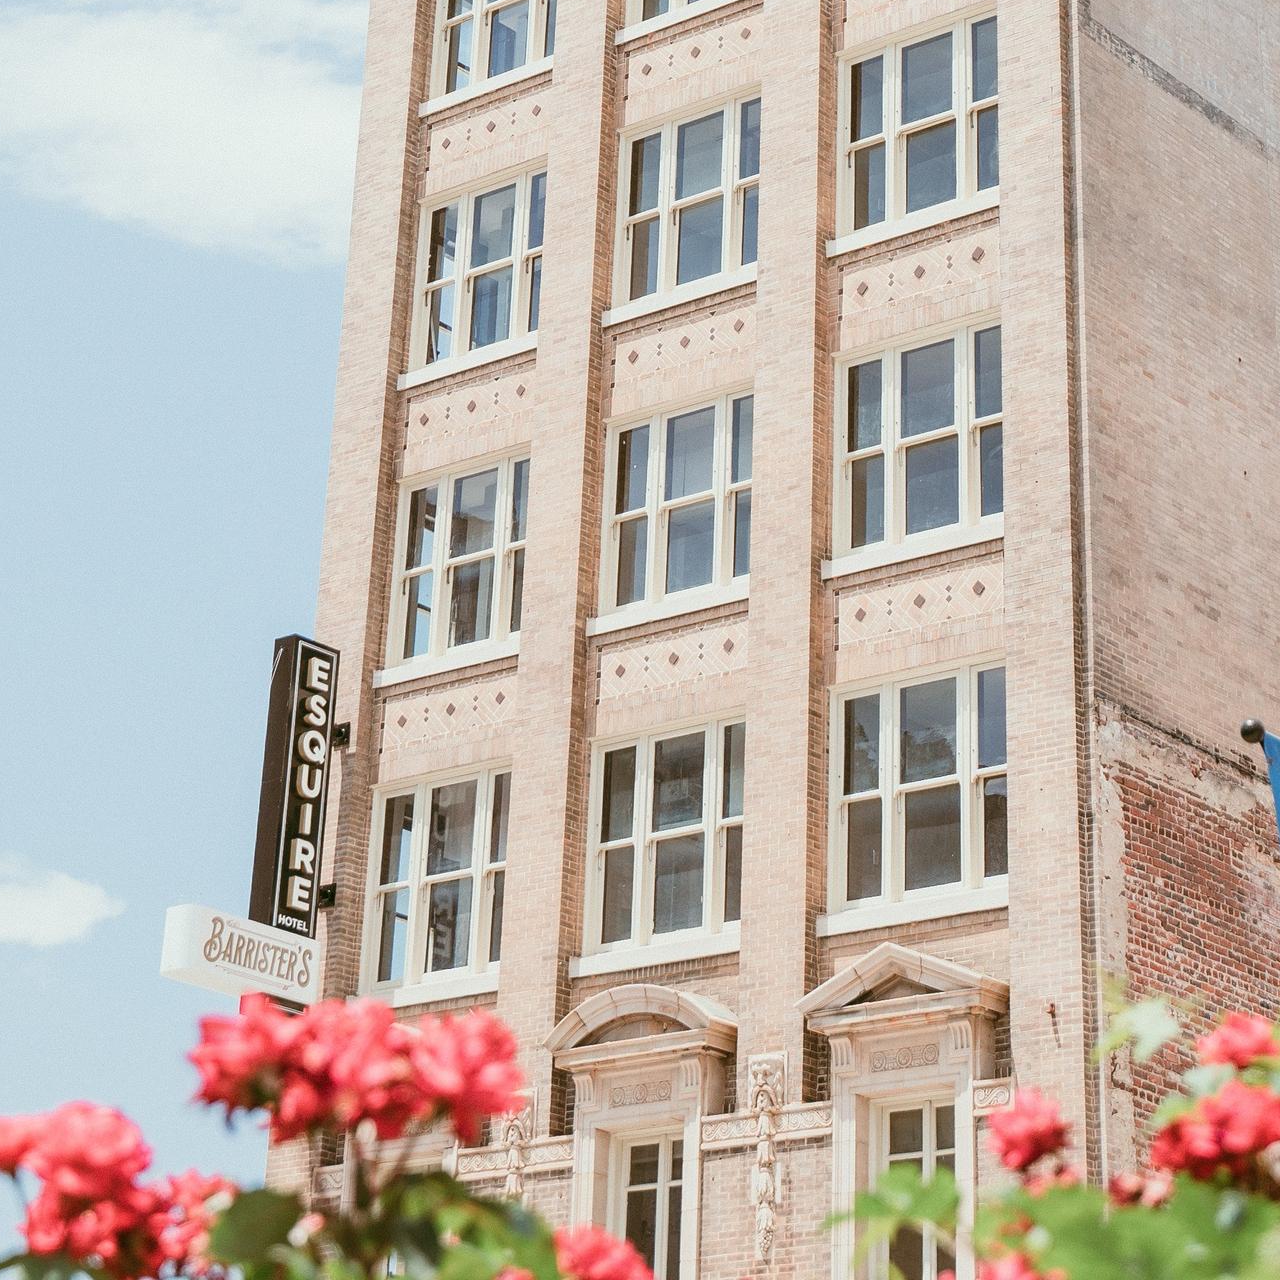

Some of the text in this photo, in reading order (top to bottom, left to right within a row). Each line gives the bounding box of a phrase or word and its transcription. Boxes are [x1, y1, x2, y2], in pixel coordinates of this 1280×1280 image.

[287, 656, 330, 911] ESQUIRE
[203, 915, 313, 988] BARRISTER'S
[277, 913, 309, 933] HOTEL
